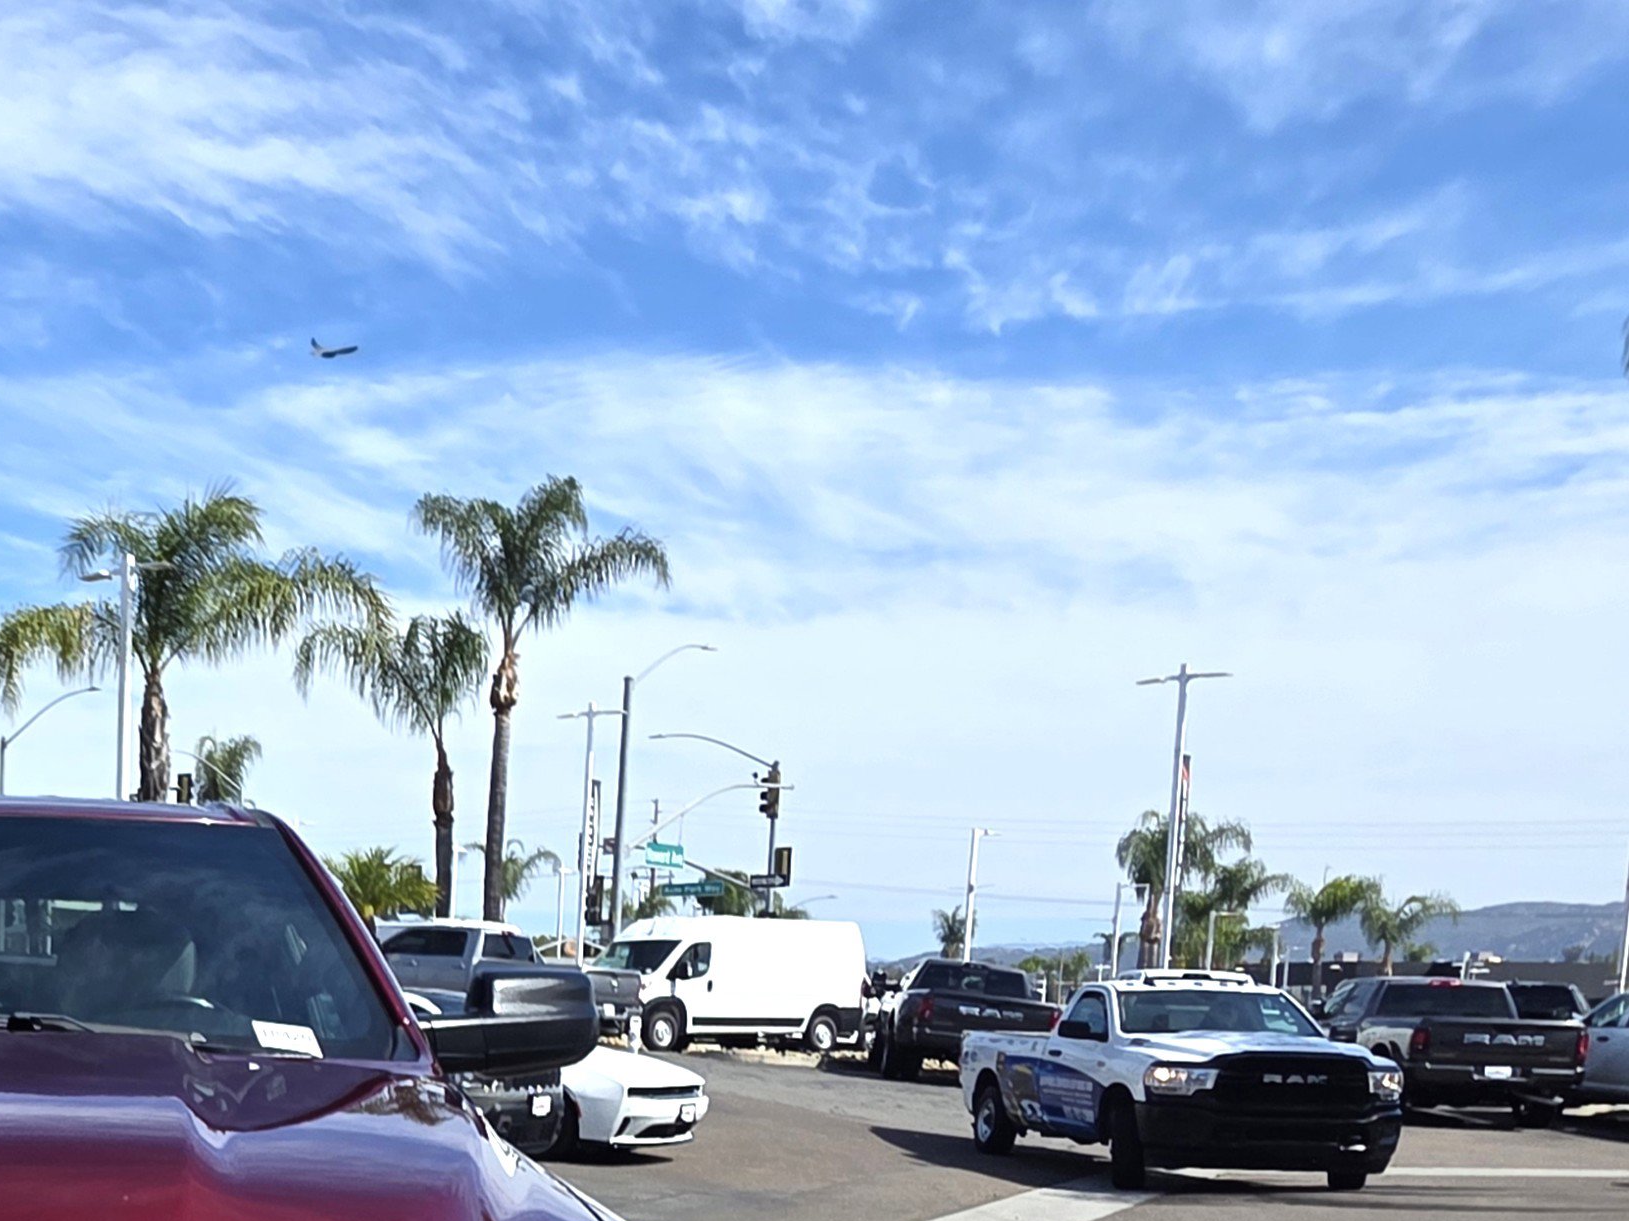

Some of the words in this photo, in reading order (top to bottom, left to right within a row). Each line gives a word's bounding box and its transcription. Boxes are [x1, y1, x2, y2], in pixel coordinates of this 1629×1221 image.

[958, 1005, 1024, 1022] RAM
[1463, 1033, 1546, 1047] RAM
[1263, 1073, 1328, 1085] RAM
